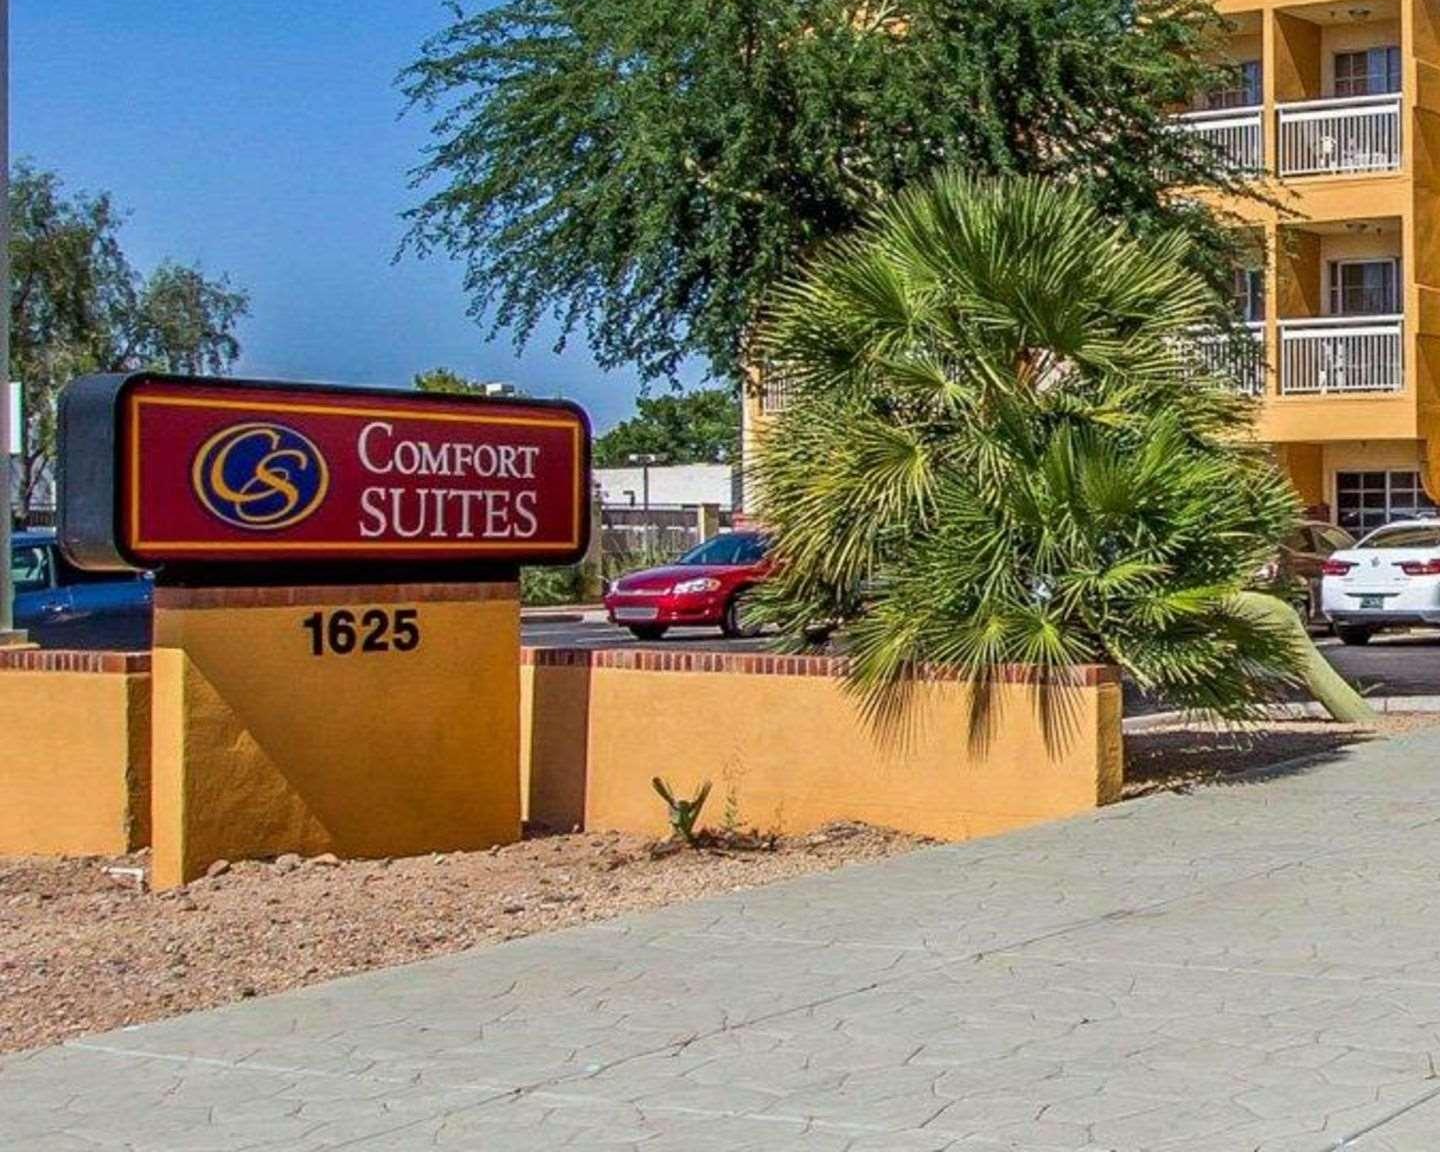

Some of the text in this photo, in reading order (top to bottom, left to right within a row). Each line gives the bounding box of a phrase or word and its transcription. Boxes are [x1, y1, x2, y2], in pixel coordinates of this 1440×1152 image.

[357, 421, 540, 479] COMFORT
[358, 486, 538, 538] SUITES
[303, 608, 420, 656] 1625
